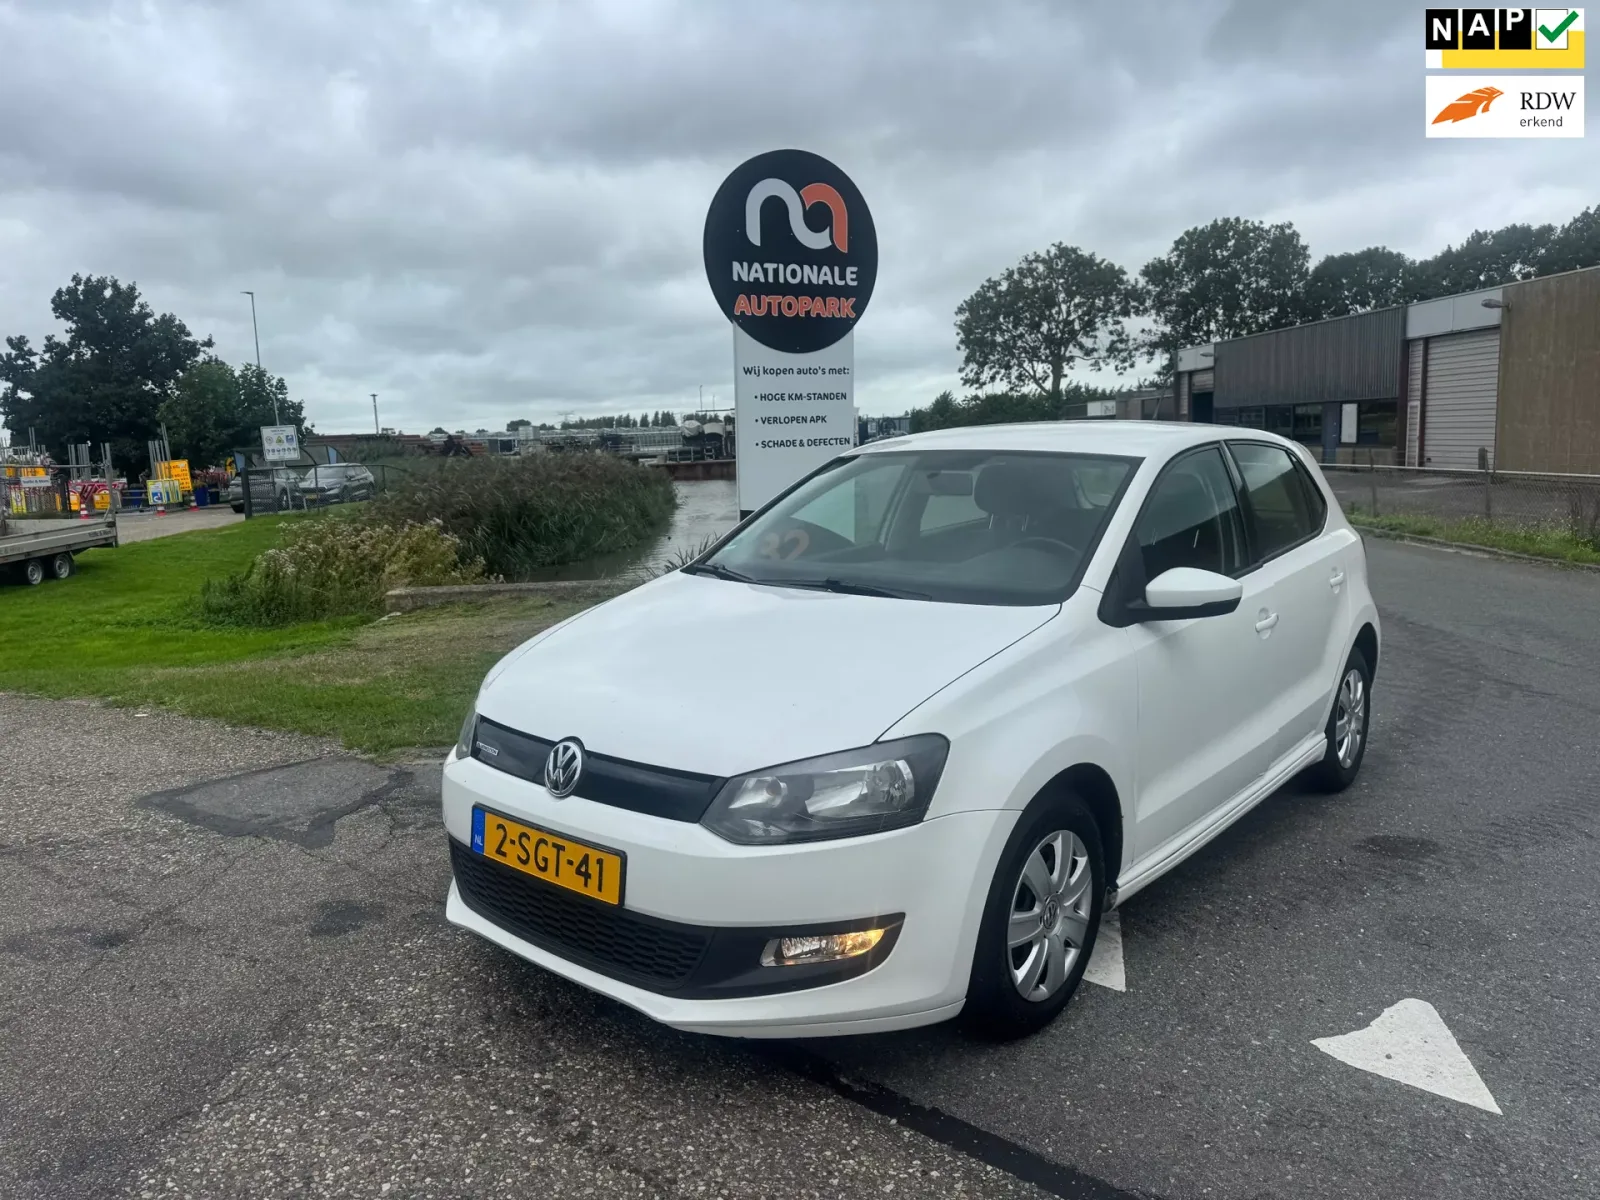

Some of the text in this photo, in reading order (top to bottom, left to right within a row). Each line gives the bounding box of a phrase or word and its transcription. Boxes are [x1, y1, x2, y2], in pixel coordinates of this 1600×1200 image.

[731, 261, 859, 286] NATIONALE
[734, 294, 857, 319] AUTOPARK
[743, 366, 850, 377] Wij kopen auto's met:
[760, 392, 847, 402] HOGE KM-STANDEN
[760, 415, 828, 425] VERLOPEN APK
[761, 437, 851, 449] SCHADE & DEFECTEN
[474, 834, 483, 846] NL
[494, 823, 605, 893] 2-SGT-41
